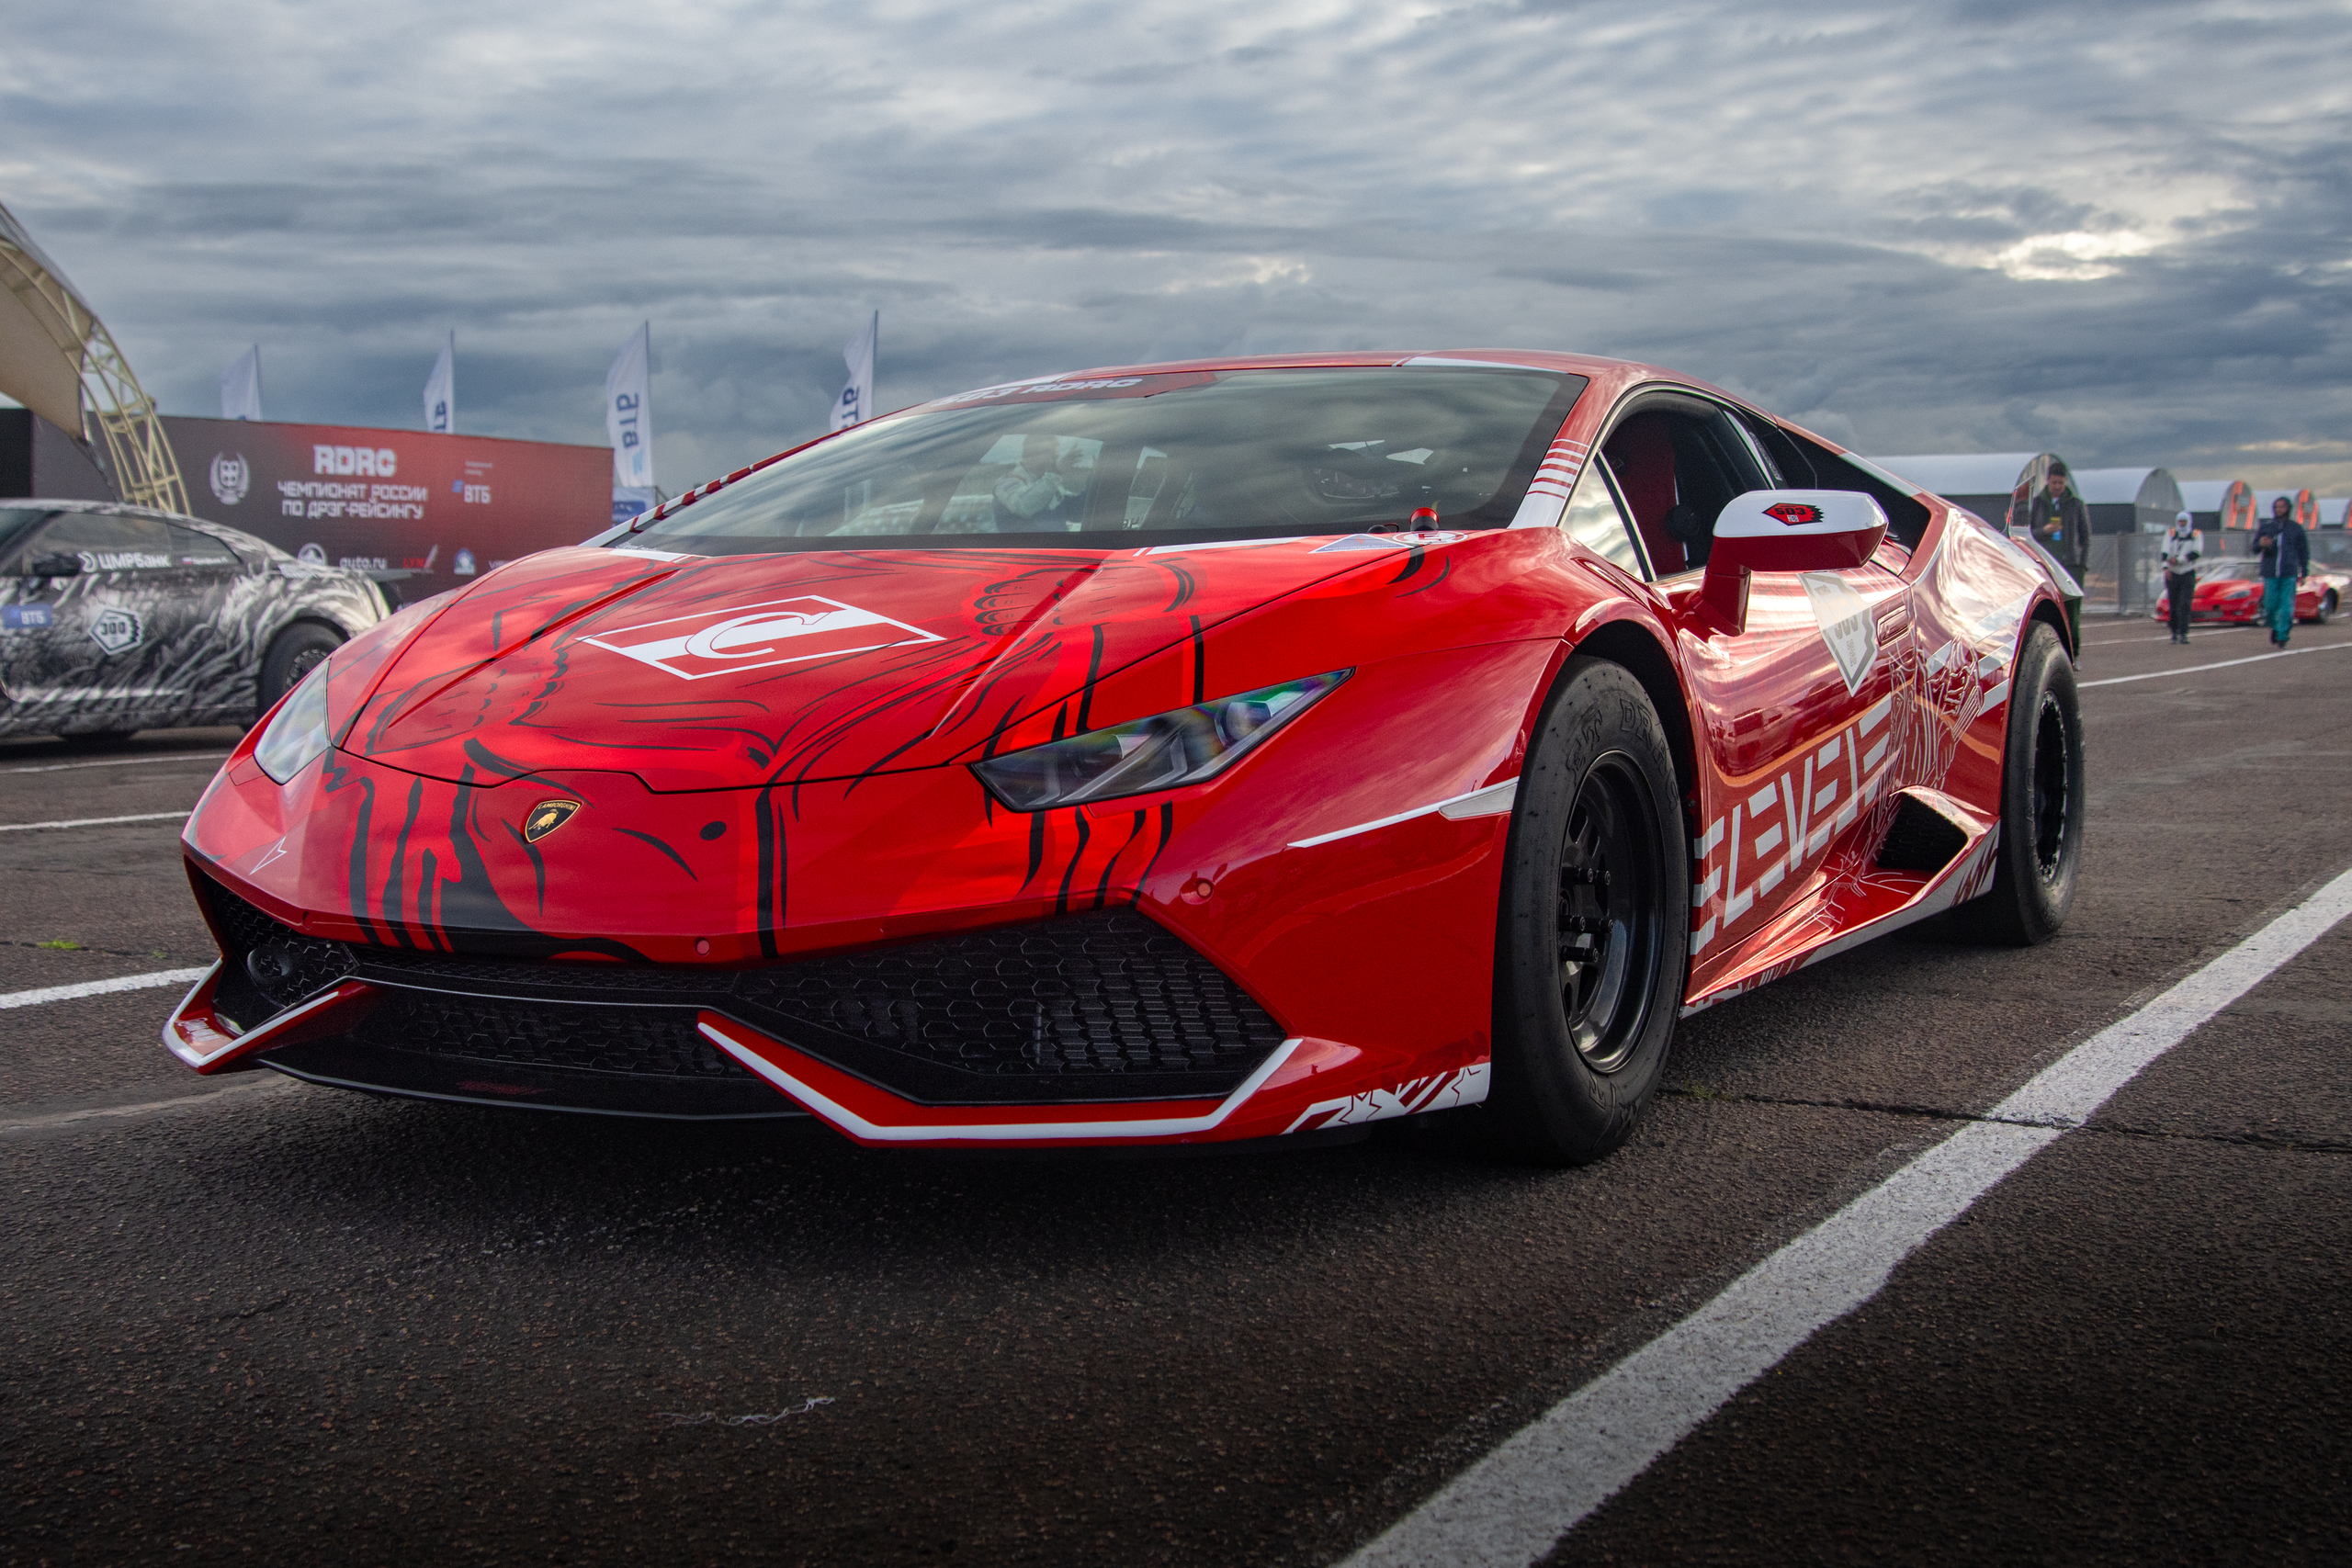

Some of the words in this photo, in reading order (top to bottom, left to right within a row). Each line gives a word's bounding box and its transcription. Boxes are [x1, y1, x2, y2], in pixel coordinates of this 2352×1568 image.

[313, 445, 397, 477] RDRC
[277, 480, 367, 499] ЧЕМПИОНАТ
[370, 484, 428, 502] РОССИИ
[463, 484, 492, 503] ВТБ
[282, 500, 304, 516] ПО
[1774, 507, 1806, 515] 503
[97, 553, 172, 569] ЦМРБанк
[20, 610, 45, 625] ВТБ
[1619, 698, 1679, 813] DRAG
[537, 802, 576, 810] LAMBORGHINI
